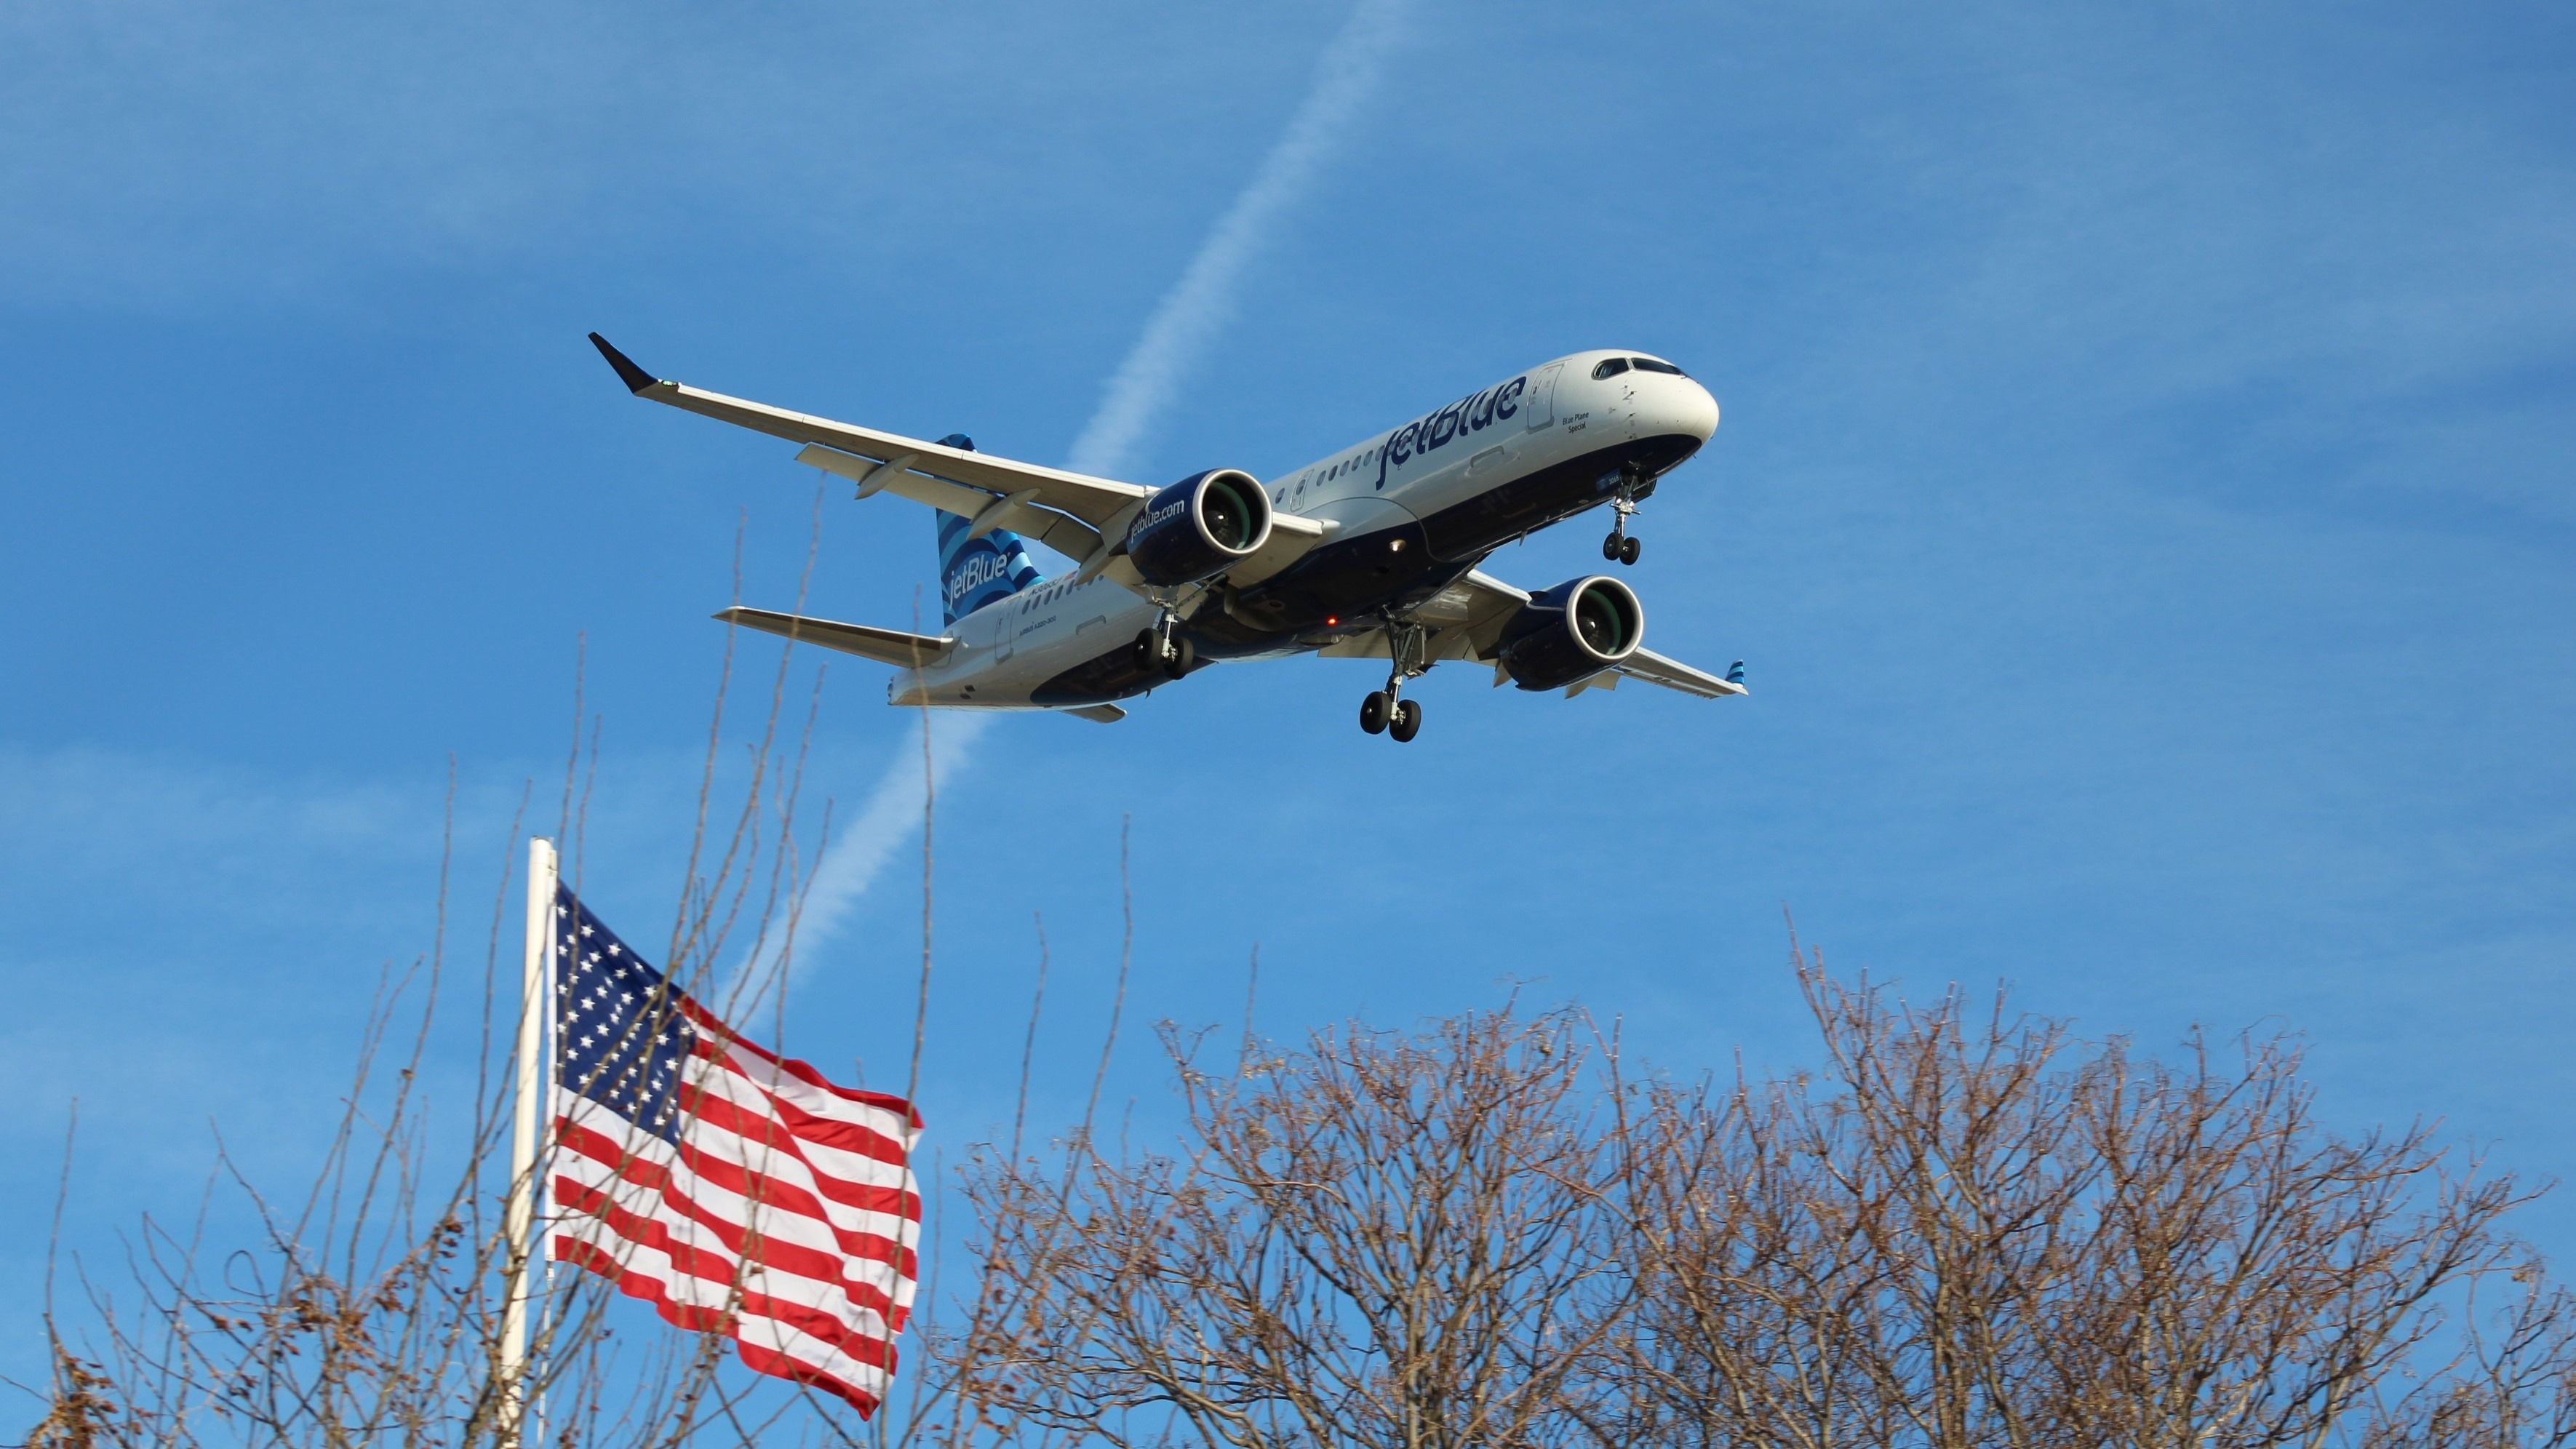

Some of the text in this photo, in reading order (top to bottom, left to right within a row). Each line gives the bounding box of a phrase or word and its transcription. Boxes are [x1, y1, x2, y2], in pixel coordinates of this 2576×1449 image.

[1376, 376, 1526, 490] jetBlue
[1563, 412, 1589, 425] Blue Plane
[1568, 421, 1586, 434] Special
[1131, 500, 1185, 544] jetblue.com
[949, 554, 1007, 612] jetBlue
